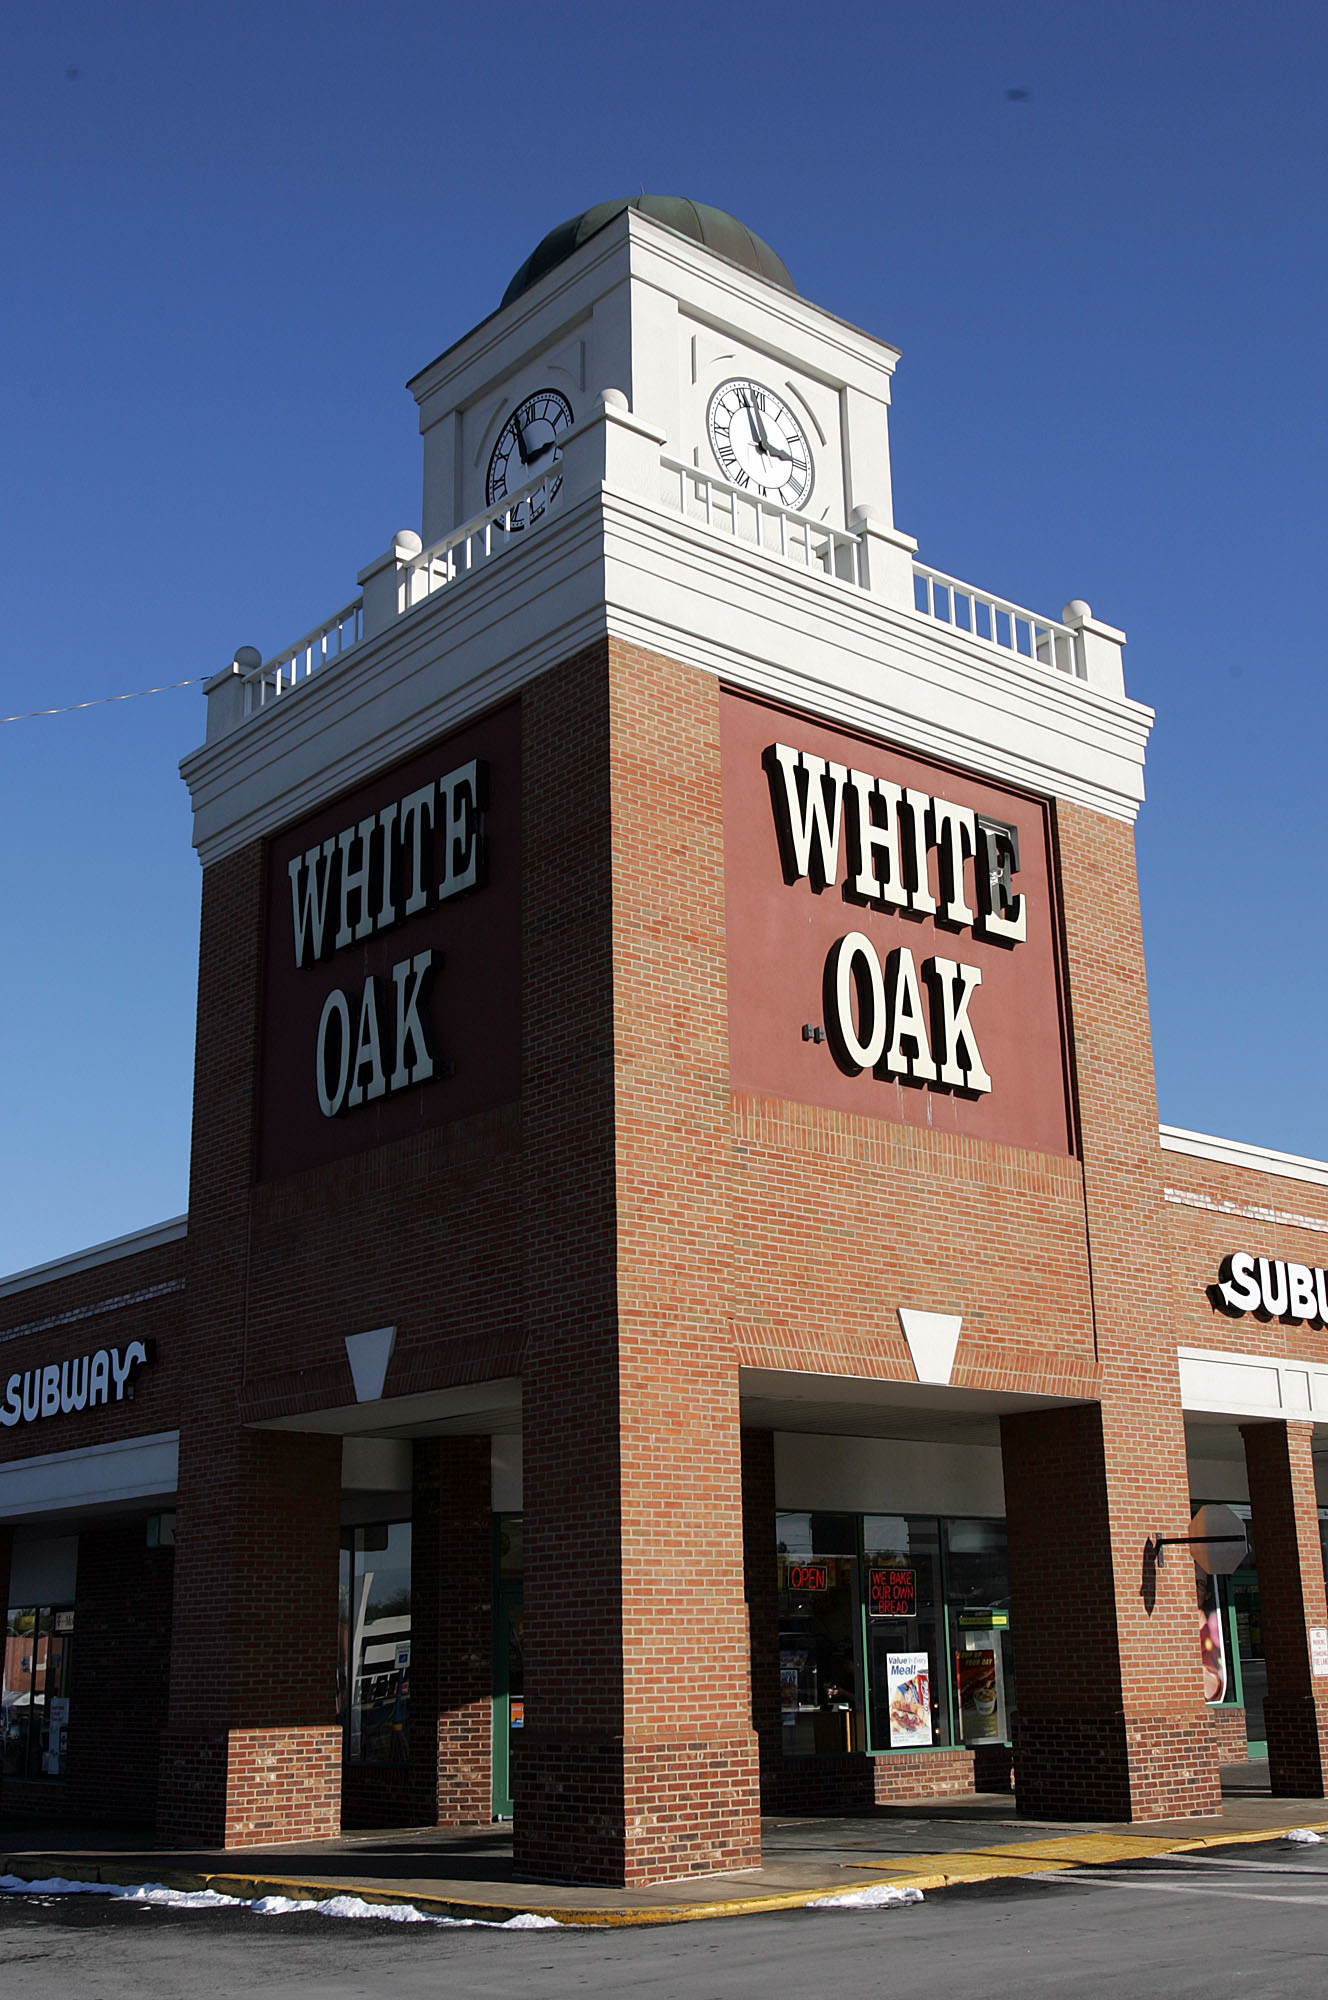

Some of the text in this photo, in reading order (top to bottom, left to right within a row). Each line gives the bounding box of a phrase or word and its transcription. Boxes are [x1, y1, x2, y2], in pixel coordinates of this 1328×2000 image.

[773, 742, 1026, 945] WHITE
[287, 757, 479, 969] WHITE
[834, 930, 993, 1095] OAK
[316, 948, 434, 1119] OAK
[0, 1340, 148, 1427] SUBWAY
[791, 1566, 825, 1589] OPEN
[871, 1571, 913, 1586] WE BAKE
[871, 1585, 914, 1600] OUR OWN
[878, 1600, 909, 1614] BREAD
[888, 1657, 908, 1665] Value
[890, 1665, 916, 1676] Meal!
